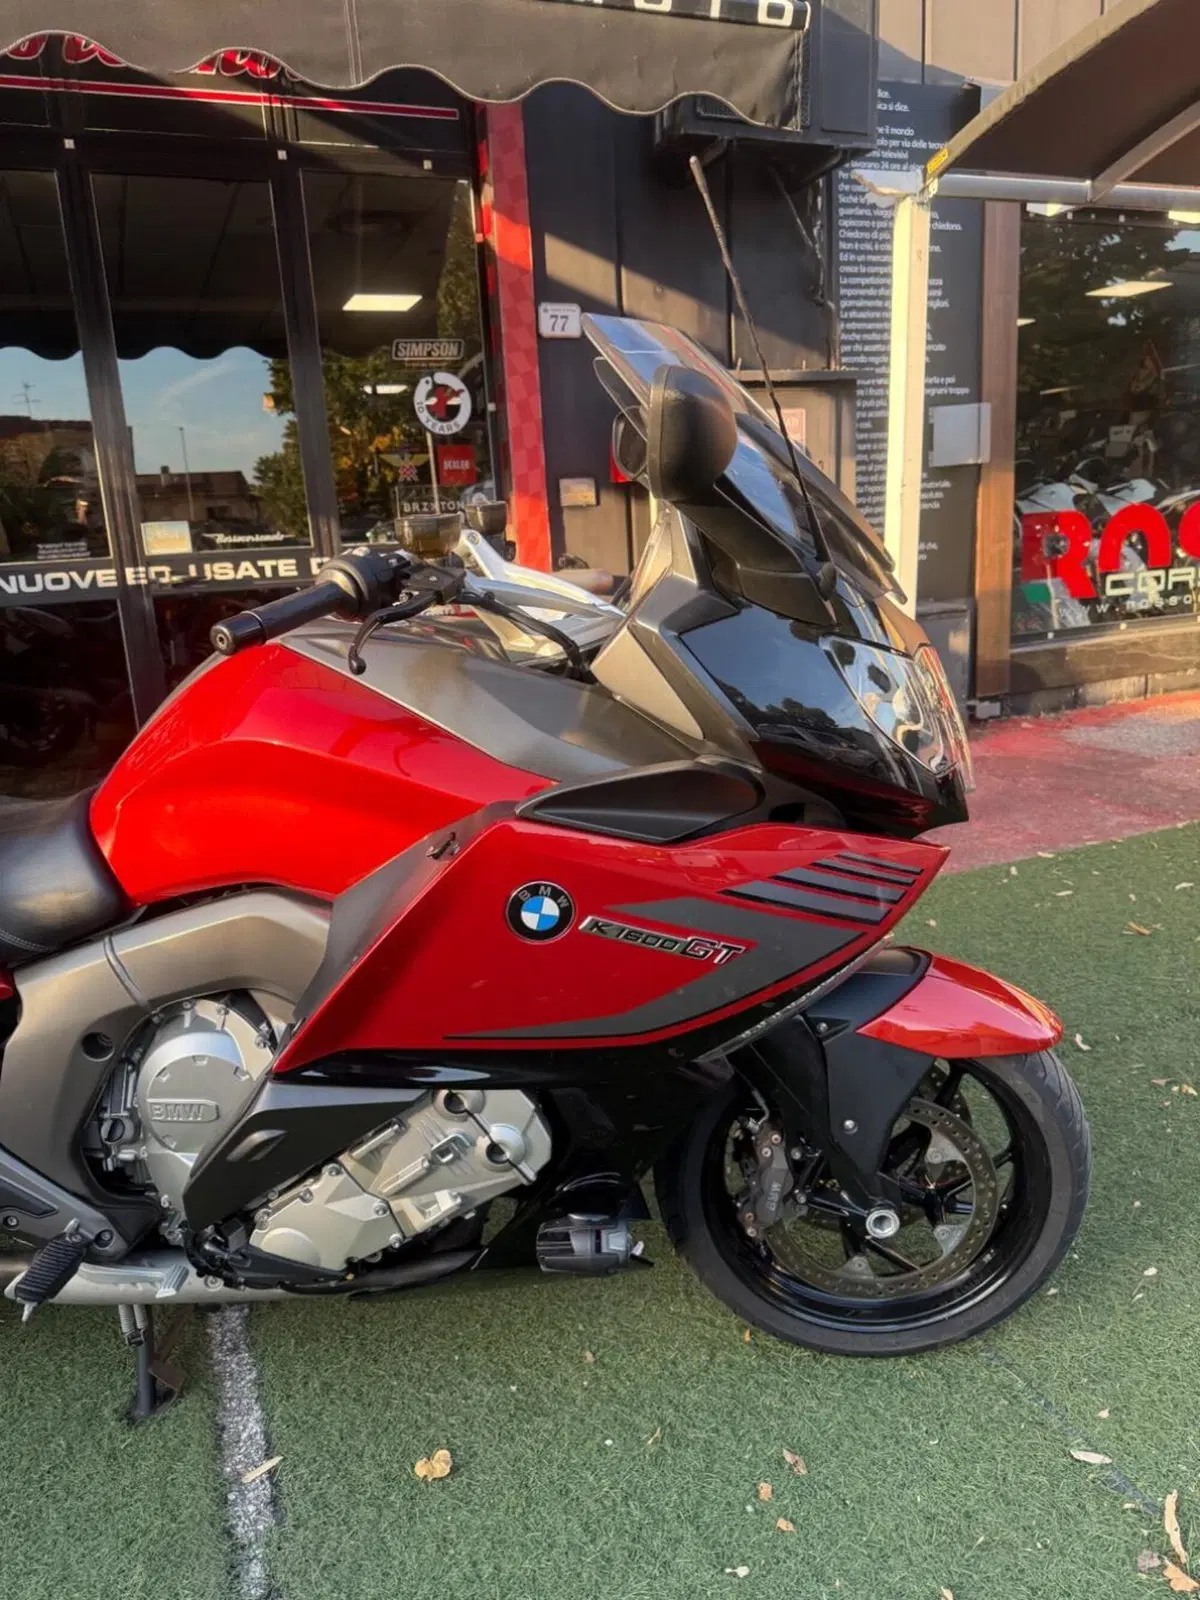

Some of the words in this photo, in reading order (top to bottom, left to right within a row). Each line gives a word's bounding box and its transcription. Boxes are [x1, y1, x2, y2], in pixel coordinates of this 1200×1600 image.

[550, 314, 569, 332] 77
[397, 342, 459, 357] SIMPSON
[425, 416, 461, 433] YEARS
[518, 885, 571, 908] BMW
[151, 1103, 205, 1121] BMW
